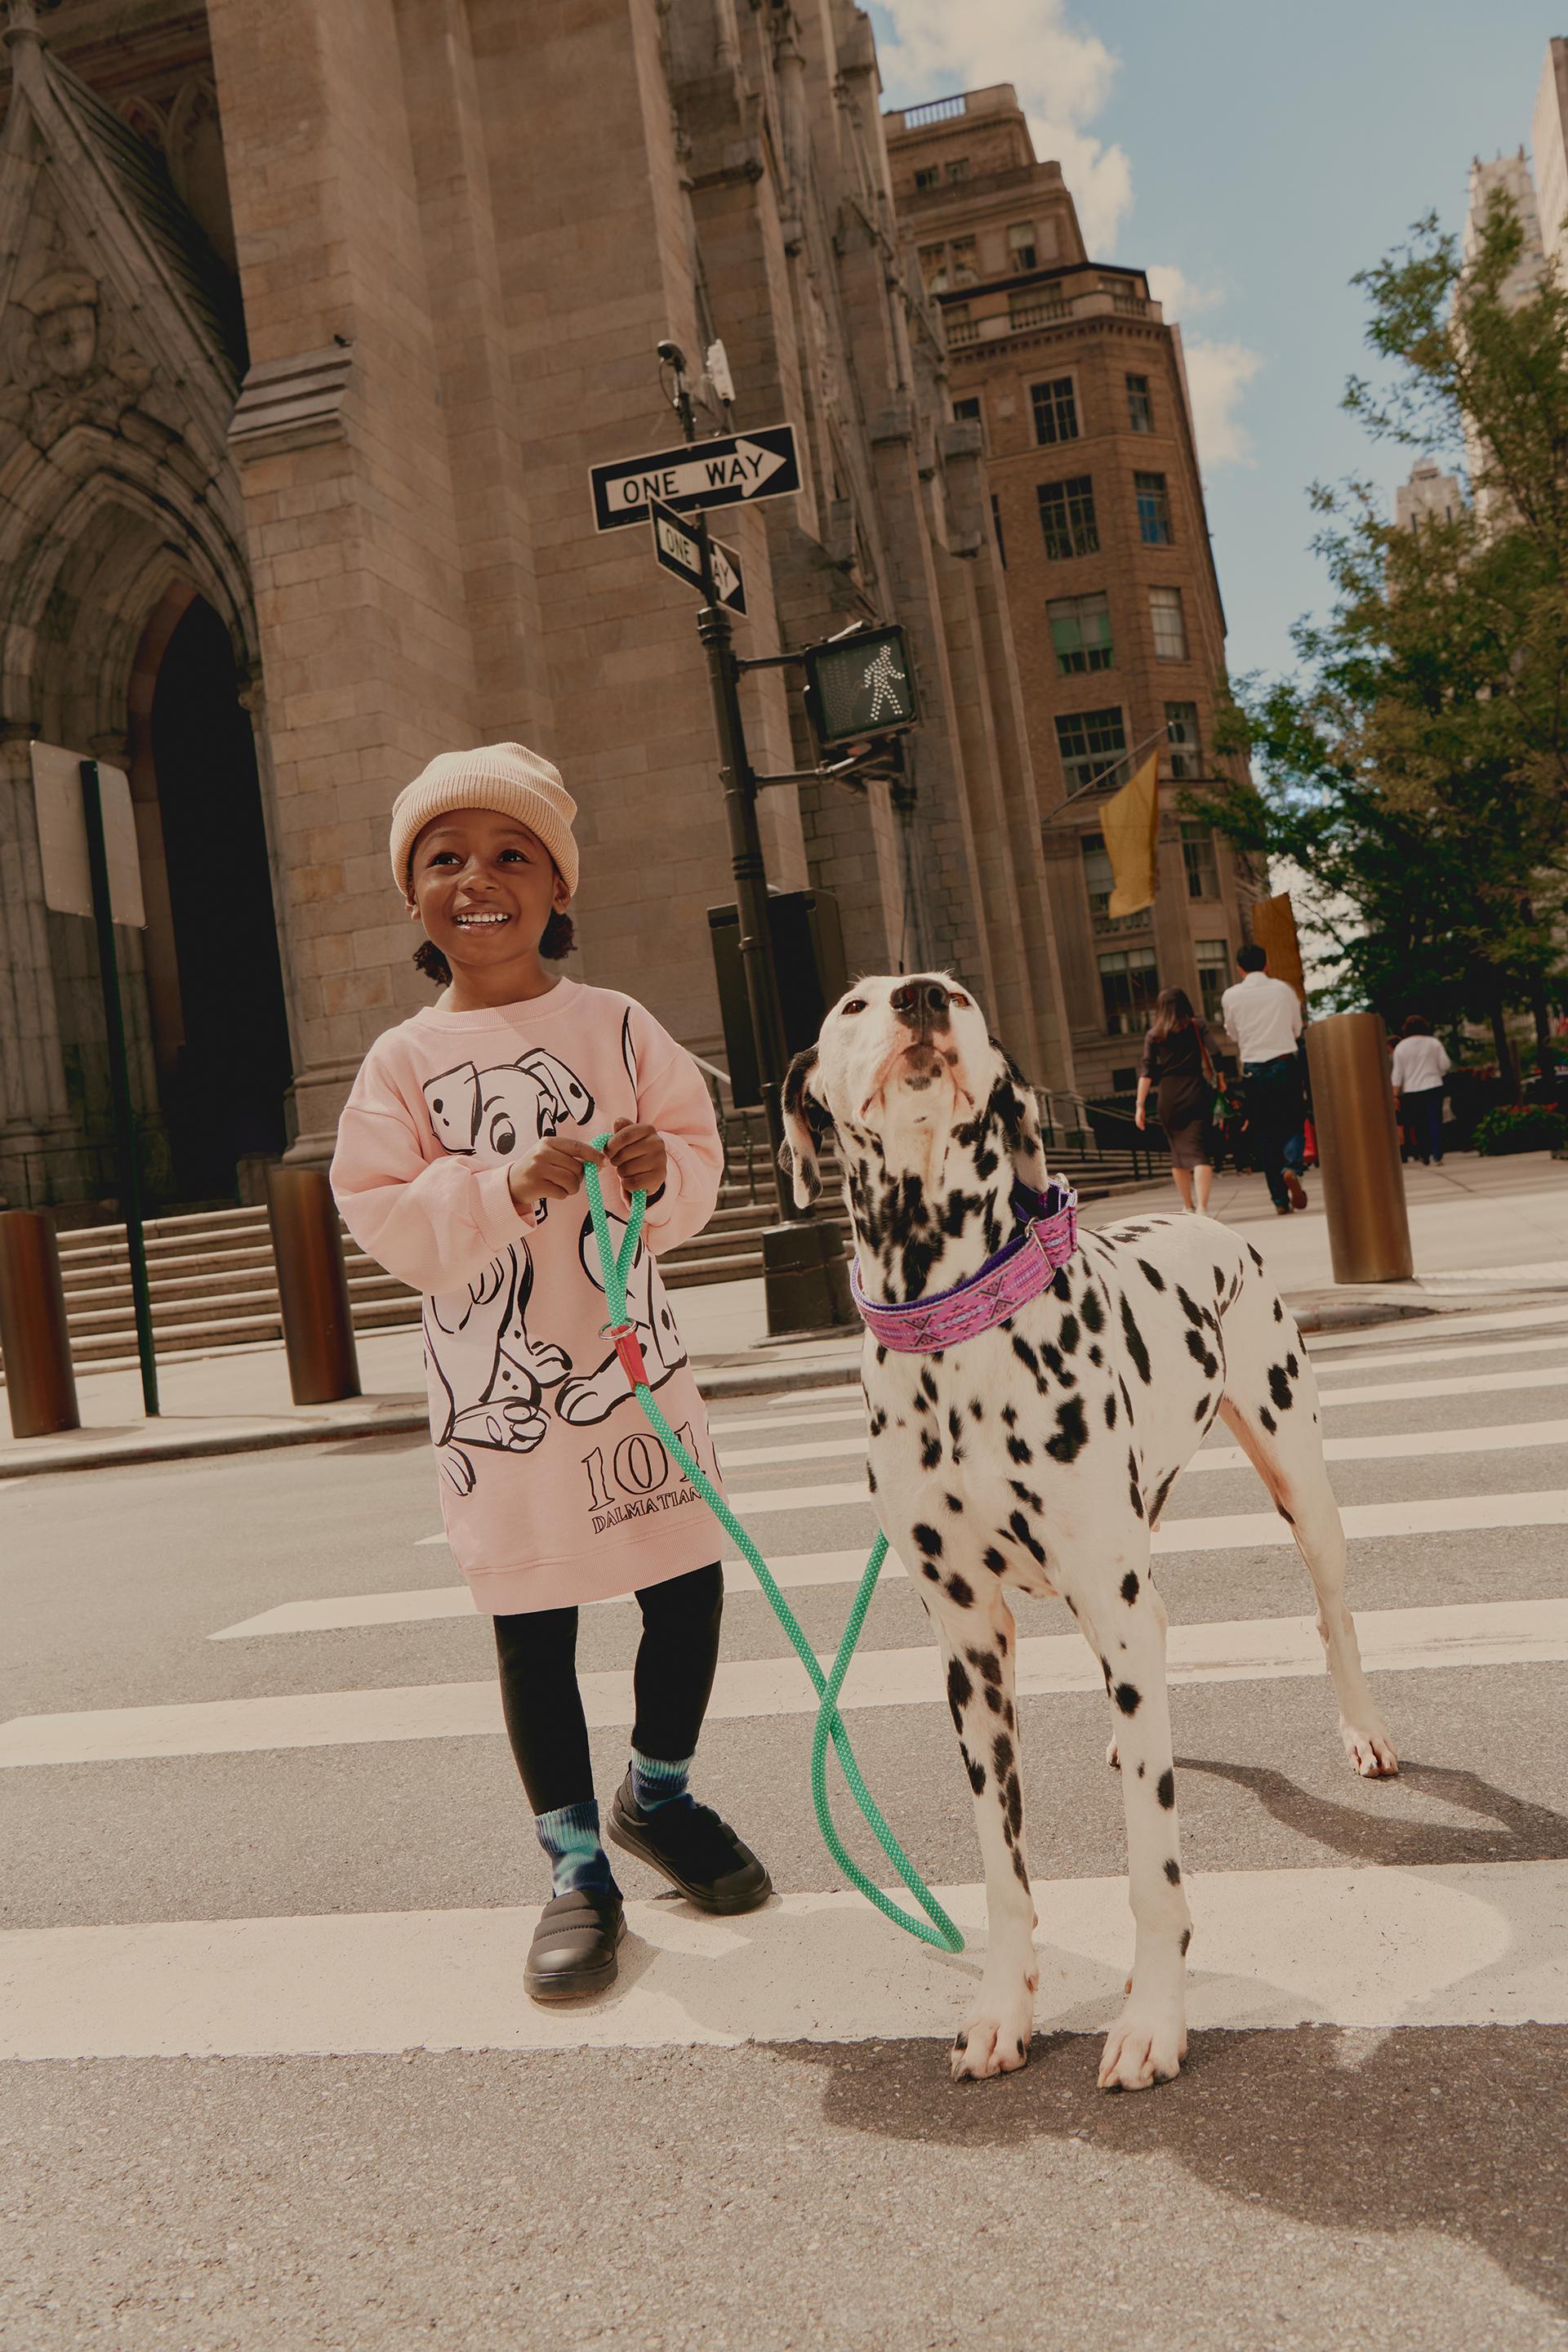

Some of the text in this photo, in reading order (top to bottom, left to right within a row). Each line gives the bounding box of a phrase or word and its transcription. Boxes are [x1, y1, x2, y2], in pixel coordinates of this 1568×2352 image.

[623, 452, 764, 503] ONE WAY
[666, 528, 729, 588] ONE AY
[591, 1486, 702, 1535] DALMATIAN
